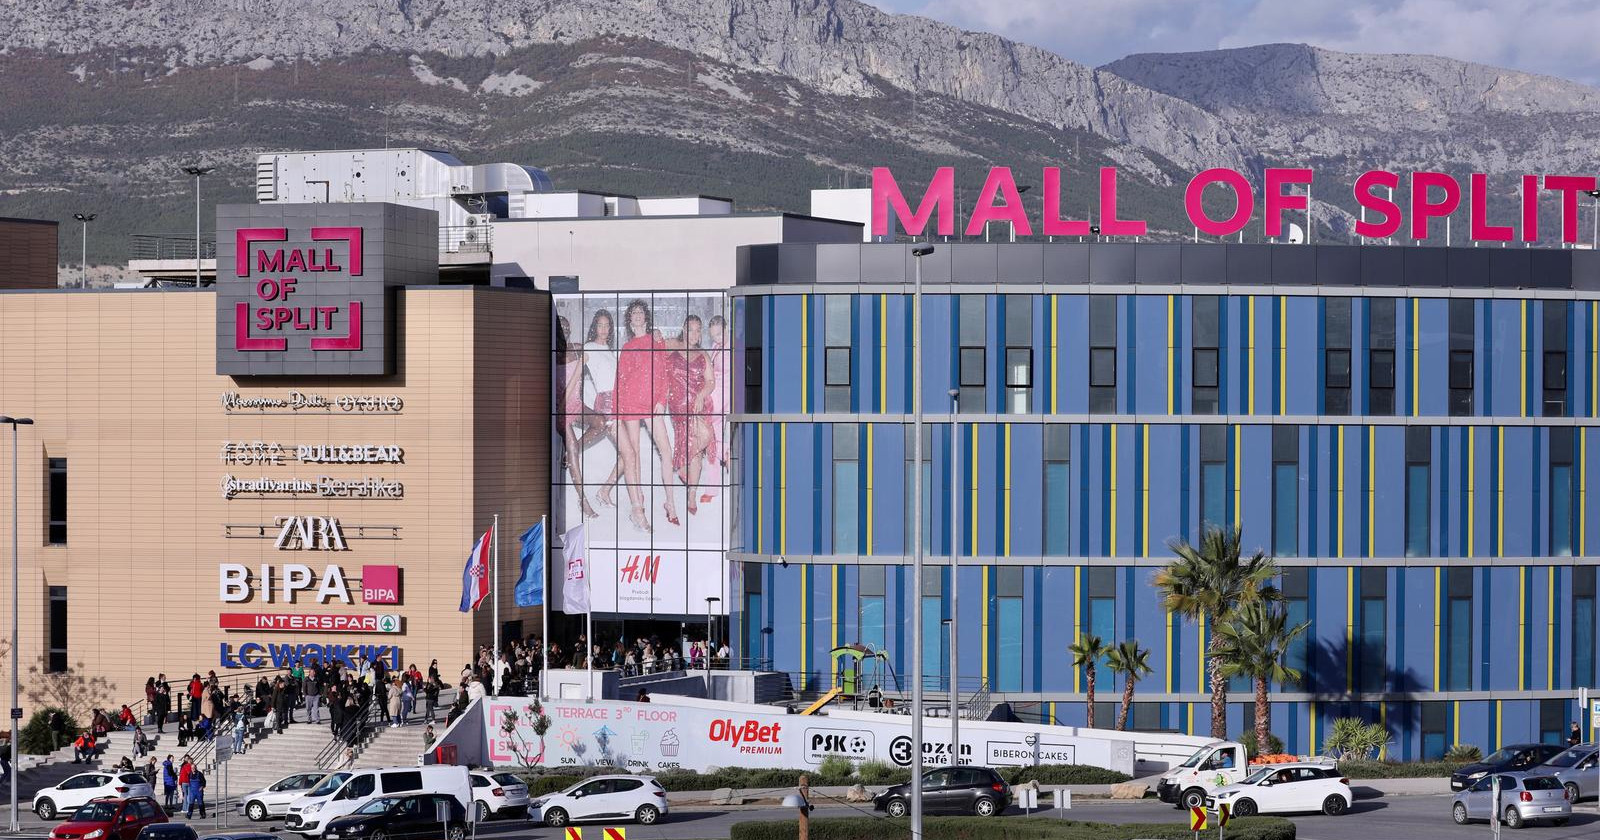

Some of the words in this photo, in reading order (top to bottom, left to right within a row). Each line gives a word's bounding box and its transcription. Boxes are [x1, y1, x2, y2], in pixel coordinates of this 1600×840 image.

[871, 166, 1147, 236] MALL
[1184, 167, 1313, 236] OF
[1353, 170, 1597, 243] SPLIT
[257, 249, 340, 272] MALL
[256, 278, 296, 300] OF
[256, 306, 337, 330] SPLIT
[222, 442, 281, 452] ZARA
[297, 444, 401, 463] PULL&BEAR
[221, 453, 282, 464] HOME
[220, 474, 312, 497] Stradivarius
[273, 515, 349, 549] ZARA
[620, 554, 661, 584] H&M
[219, 563, 350, 603] BIPA
[364, 589, 395, 601] BIPA
[255, 615, 377, 629] INTERSPAR
[556, 706, 608, 720] TERRACE
[637, 709, 677, 722] FLOOR
[709, 718, 782, 748] OlyBet
[740, 745, 782, 754] PREMIUM
[812, 733, 847, 753] PSK
[560, 757, 576, 765] SUN
[628, 759, 649, 768] DRINK
[993, 749, 1035, 759] BIBERON
[1037, 751, 1068, 761] CAKES
[658, 761, 680, 769] CAKES
